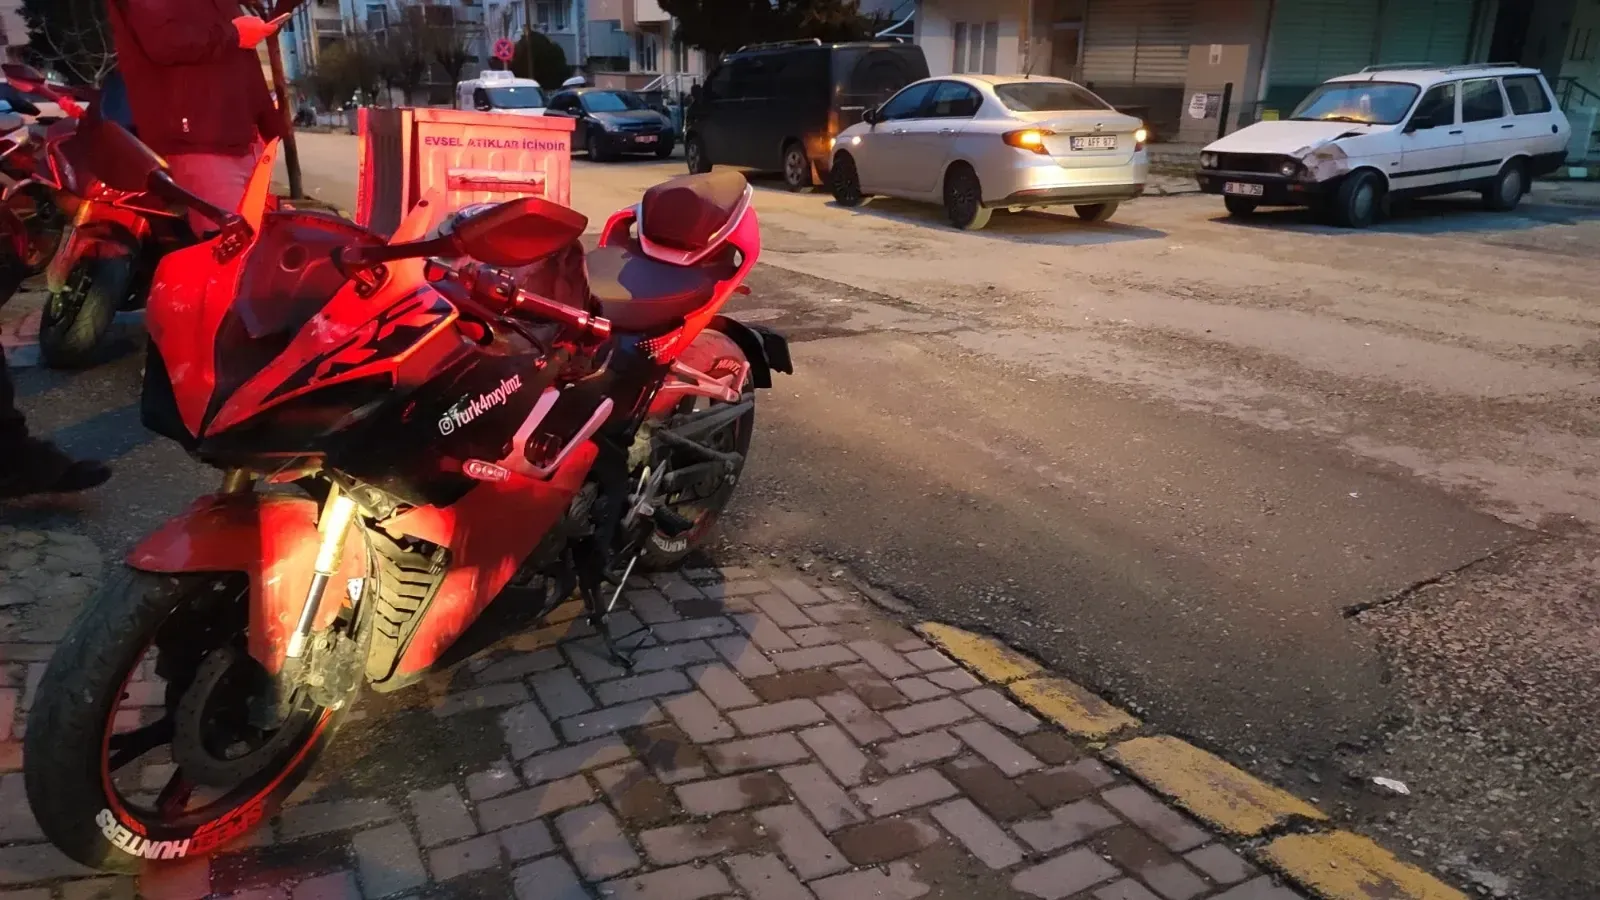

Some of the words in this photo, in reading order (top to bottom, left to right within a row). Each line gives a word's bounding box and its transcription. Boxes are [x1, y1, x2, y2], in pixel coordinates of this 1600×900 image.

[424, 136, 464, 147] EVSEL
[1075, 138, 1085, 147] 22
[1087, 137, 1101, 147] AFF
[95, 808, 191, 860] HUNTERS
